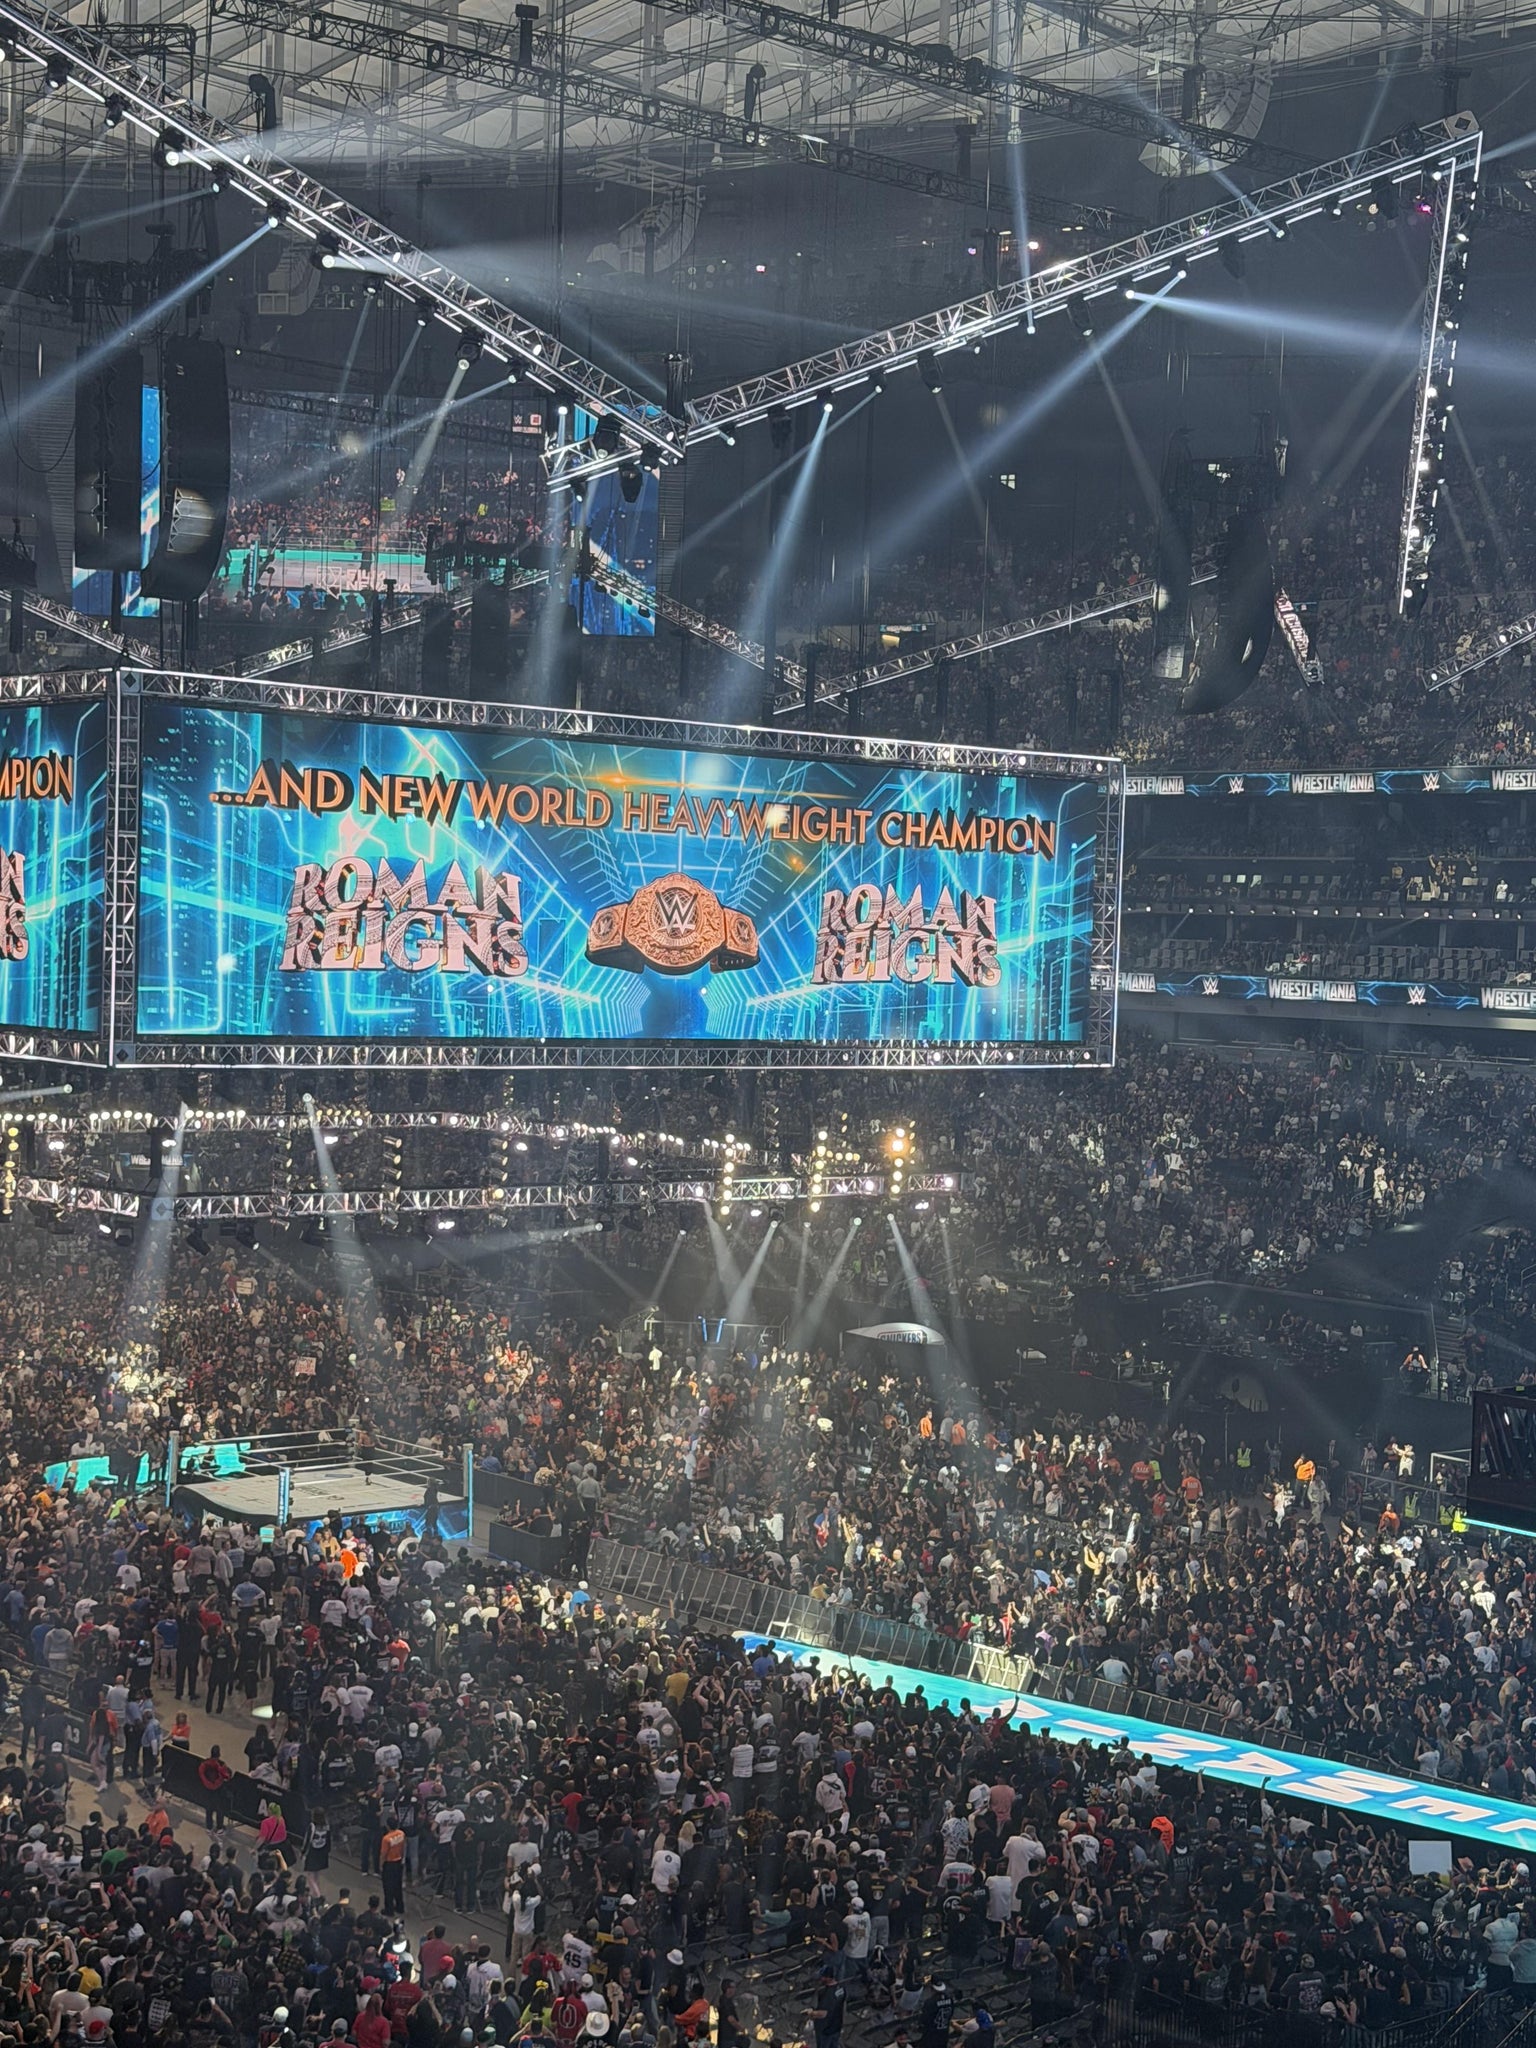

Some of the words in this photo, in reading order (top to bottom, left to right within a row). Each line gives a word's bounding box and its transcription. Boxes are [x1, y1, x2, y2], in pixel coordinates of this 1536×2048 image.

[1109, 775, 1185, 795] WESTLEMANIA
[1292, 773, 1375, 794] WRESTLEMANIA
[359, 766, 464, 827] NEW
[466, 777, 613, 828] WORLD
[621, 791, 873, 846] HEAVYWEIGHT
[877, 808, 1057, 860] CHAMPION
[287, 856, 522, 925] ROMAN
[818, 883, 997, 941] ROMAN
[278, 909, 530, 977] REIGNS
[810, 930, 1001, 988] REIGNS
[1268, 979, 1357, 1002] WRESTLEMANIA
[564, 1950, 582, 1968] 45
